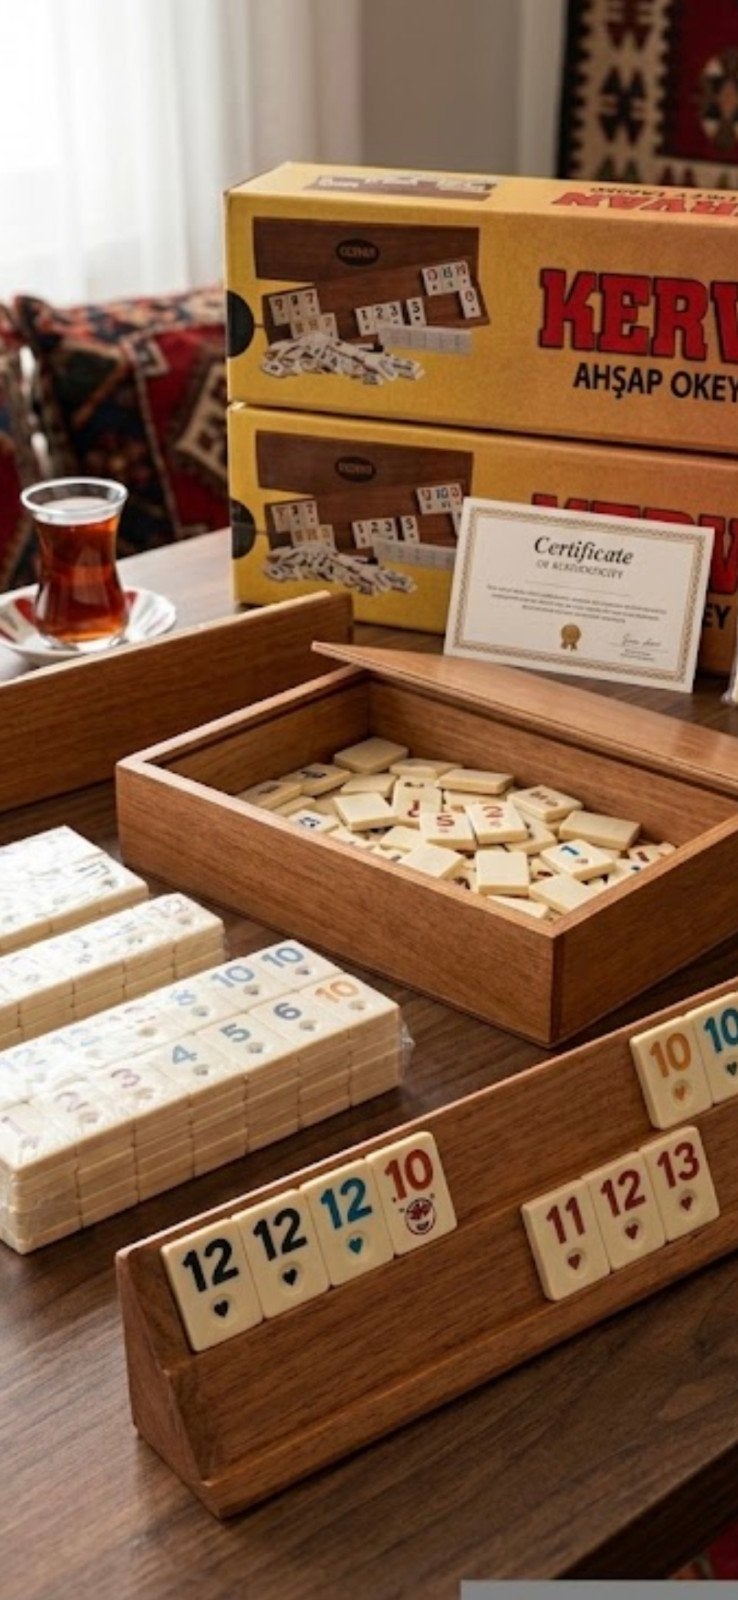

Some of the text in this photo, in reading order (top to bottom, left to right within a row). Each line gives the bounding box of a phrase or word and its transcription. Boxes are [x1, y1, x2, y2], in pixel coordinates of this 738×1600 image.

[572, 362, 663, 399] AHŞAP
[534, 535, 634, 565] Certificate
[702, 603, 731, 630] EY
[211, 965, 255, 988] 10
[262, 947, 304, 968] 10
[110, 1068, 142, 1089] 3
[172, 1044, 198, 1065] 4
[219, 1022, 251, 1043] 5
[273, 1002, 302, 1020] 6
[315, 980, 359, 1003] 10
[650, 1008, 738, 1078] 10 10
[546, 1142, 700, 1244] 11 12 13
[182, 1149, 434, 1293] 12 12 12 10
